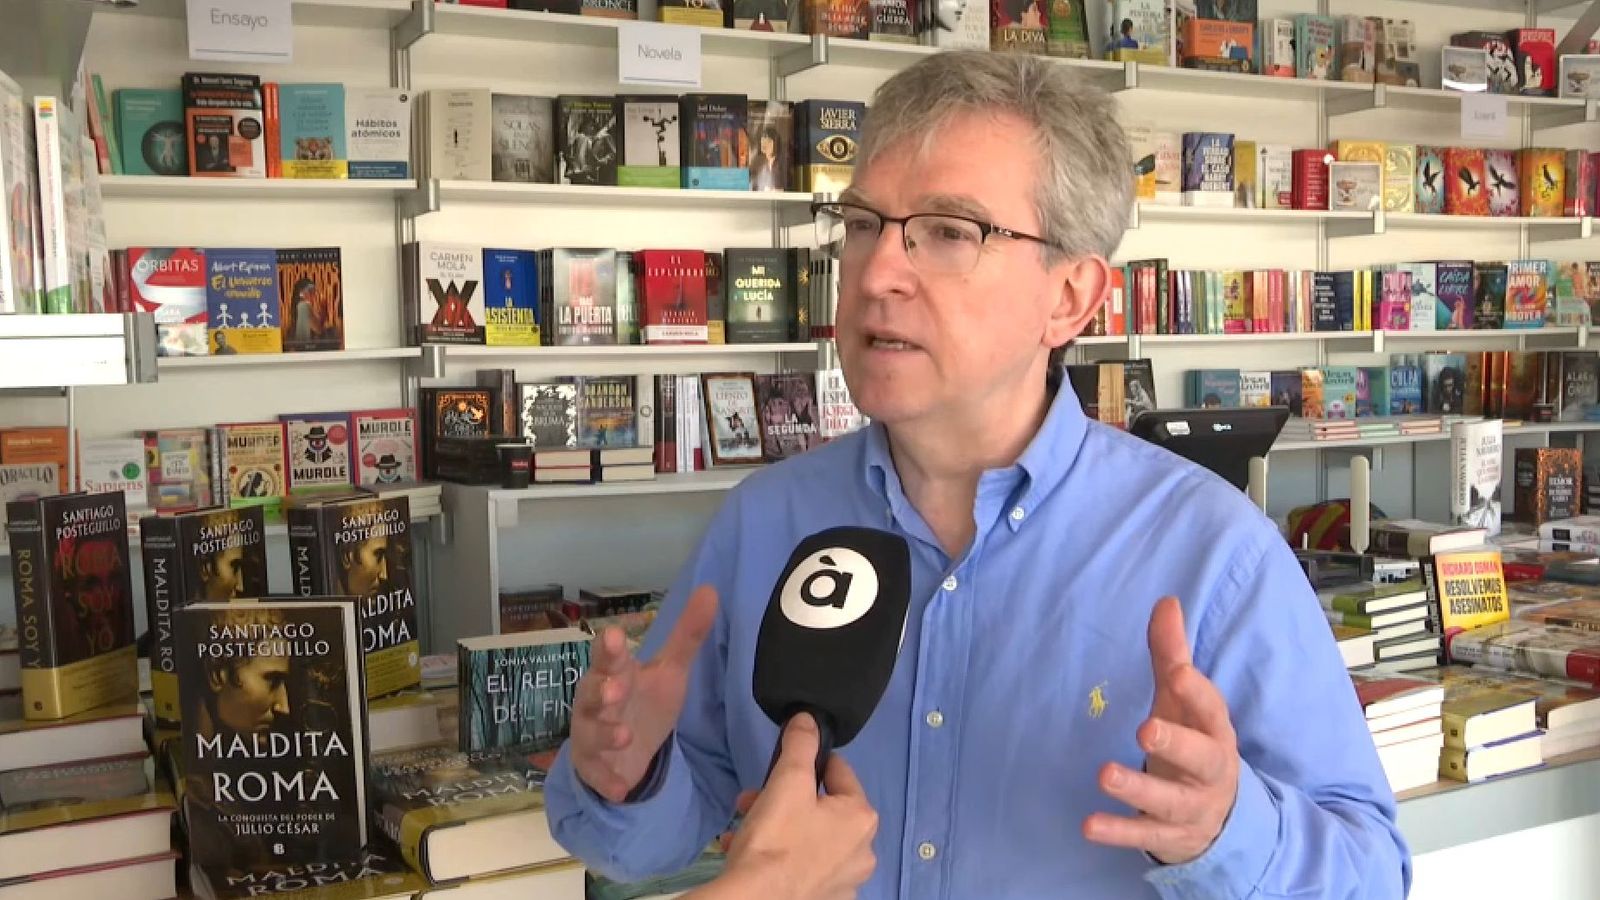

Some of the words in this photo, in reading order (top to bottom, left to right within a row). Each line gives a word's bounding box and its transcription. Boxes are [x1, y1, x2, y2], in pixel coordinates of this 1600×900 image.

[209, 7, 269, 28] Ensayo
[1004, 29, 1018, 42] LA
[1022, 31, 1045, 44] DIVA
[637, 43, 682, 61] Novela
[820, 107, 856, 119] JAVIER
[356, 118, 398, 128] Hábitos
[820, 119, 857, 131] SIERRA
[351, 128, 401, 138] atómicos
[430, 252, 473, 263] CARMEN
[438, 261, 466, 271] MOLA
[751, 265, 766, 276] MI
[735, 278, 781, 289] QUERIDA
[743, 289, 774, 301] LUCÍA
[559, 306, 572, 324] LA
[574, 306, 612, 325] PUERTA
[784, 413, 798, 423] LA
[767, 423, 817, 435] SEGUNDA
[293, 466, 347, 480] MURDLE
[85, 480, 144, 493] Sapiens
[62, 505, 114, 524] SANTIAGO
[342, 509, 399, 530] SANTIAGO
[56, 518, 121, 540] POSTEGUILLO
[199, 518, 254, 540] SANTIAGO
[335, 521, 406, 544] POSTEGUILLO
[192, 531, 261, 556] POSTEGUILLO
[60, 546, 122, 580] ROMA
[1442, 562, 1473, 576] RICHARD
[1474, 561, 1499, 574] OSMAN
[17, 549, 34, 608] ROMA
[1445, 578, 1502, 595] RESOLVEMOS
[78, 588, 114, 617] SOY
[153, 558, 173, 641] MALDITA
[1450, 596, 1503, 615] ASESINATOS
[23, 615, 41, 653] SOY
[209, 622, 315, 640] SANTIAGO
[197, 640, 330, 658] POSTEGUILLO
[494, 654, 527, 668] SONIA
[529, 651, 578, 664] VALIENTE
[487, 673, 512, 693] EL
[493, 703, 536, 725] DEL
[195, 730, 349, 759] MALDITA
[212, 770, 340, 802] ROMA
[218, 814, 228, 823] LA
[230, 813, 278, 822] CONQUISTA
[280, 813, 295, 821] DEL
[297, 813, 323, 821] PODER
[325, 812, 336, 821] DE
[235, 823, 274, 836] JULIO
[277, 821, 320, 834] CÉSAR
